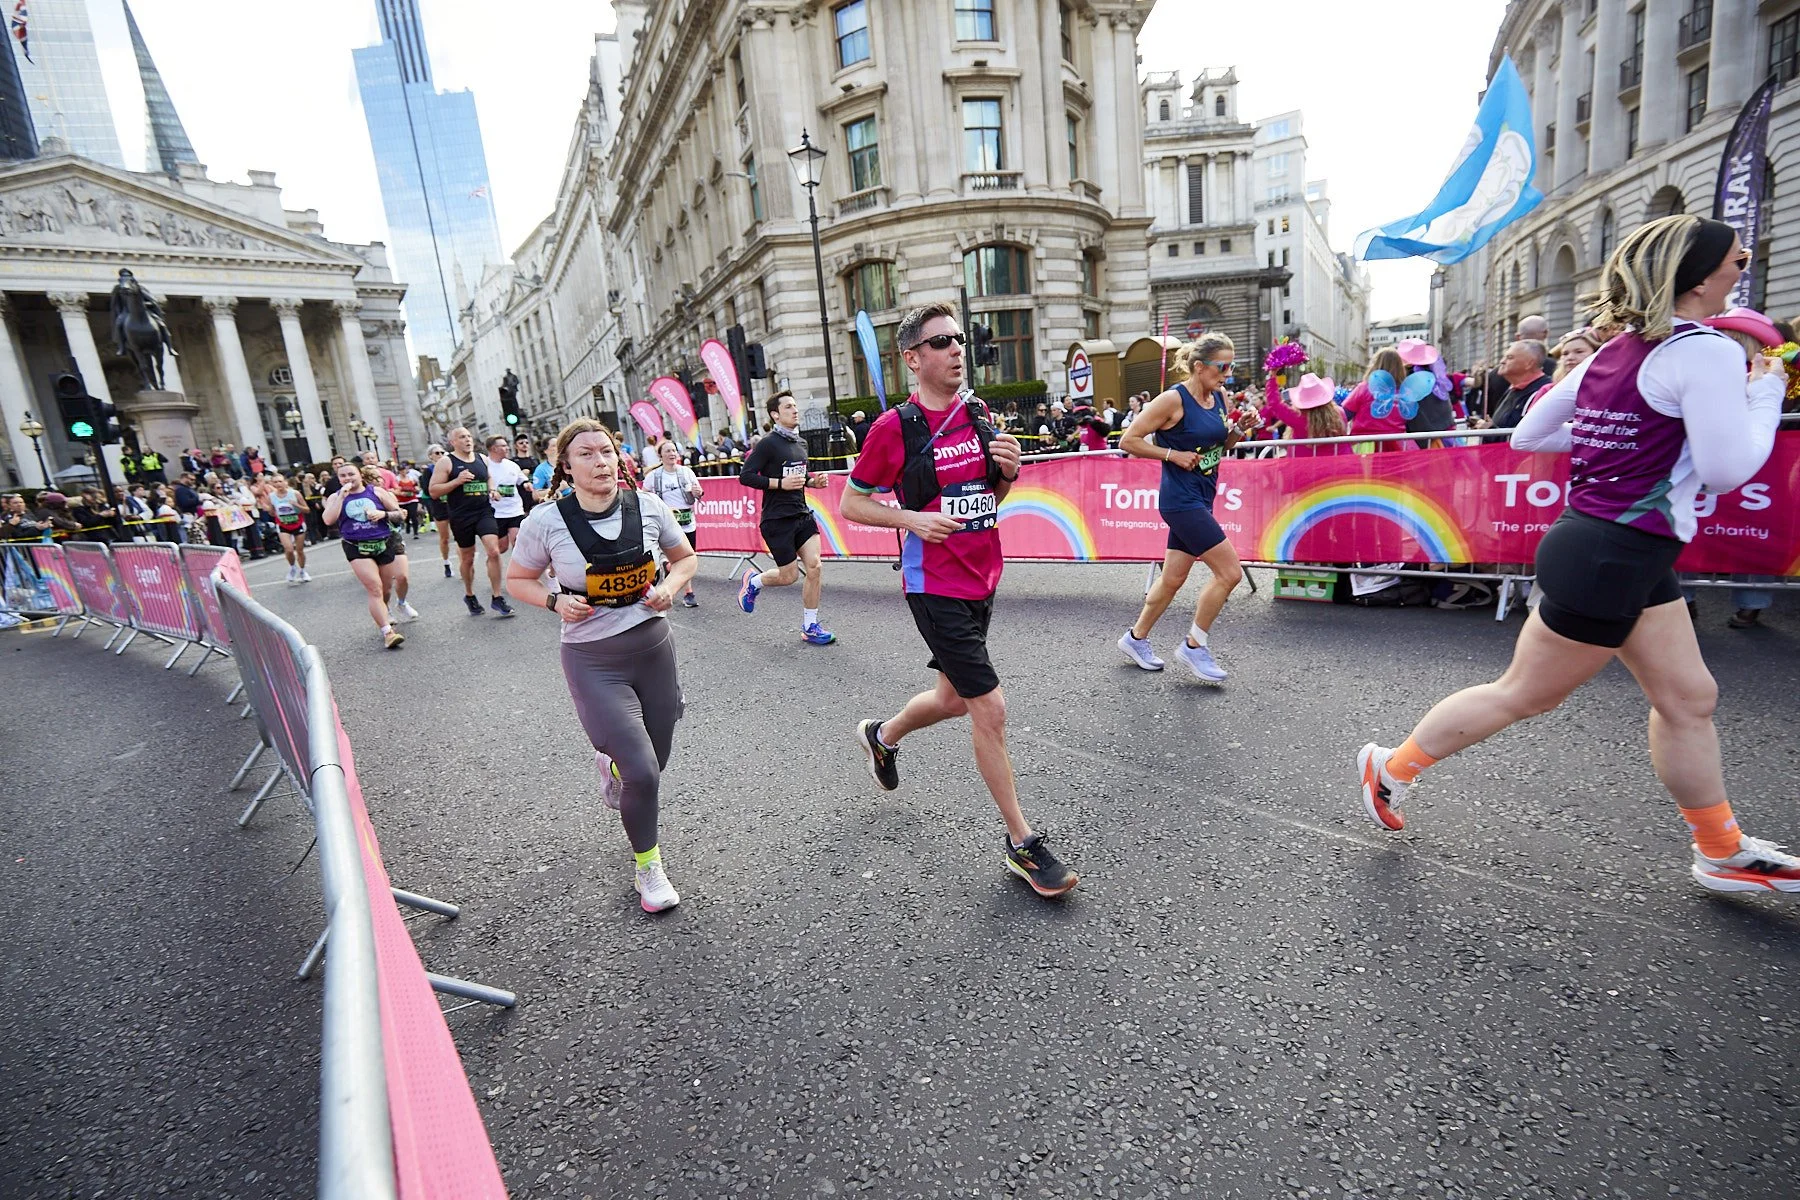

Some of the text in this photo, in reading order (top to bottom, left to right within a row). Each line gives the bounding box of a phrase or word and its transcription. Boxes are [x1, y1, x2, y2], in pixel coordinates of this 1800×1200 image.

[1616, 426, 1639, 436] the
[933, 434, 981, 461] ommy'
[1603, 441, 1640, 450] soon.
[1100, 482, 1243, 511] Tom's
[947, 495, 995, 516] 10460
[1100, 518, 1114, 527] The
[1115, 520, 1158, 530] pregnancy
[1220, 522, 1242, 532] arity
[1491, 521, 1520, 533] The
[1703, 523, 1769, 540] charity
[615, 563, 634, 572] RUTH
[598, 569, 648, 593] 4838
